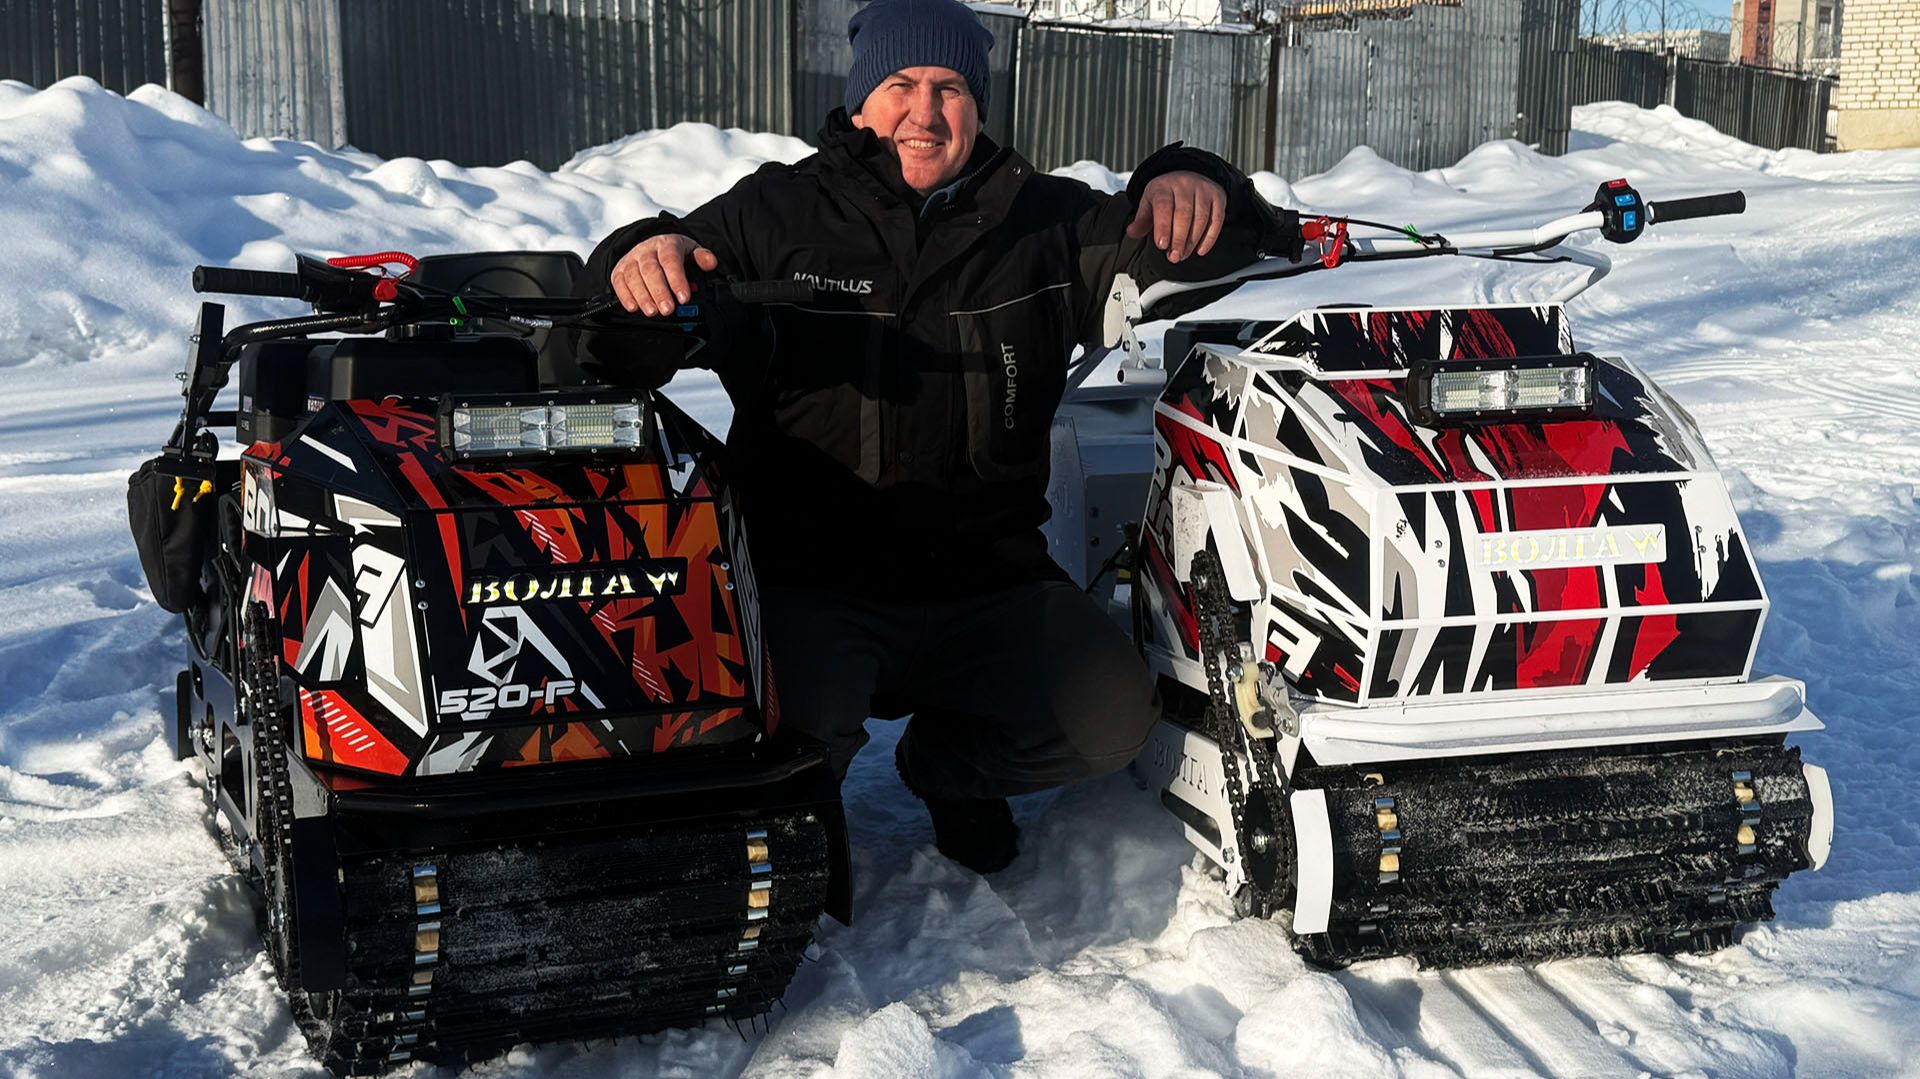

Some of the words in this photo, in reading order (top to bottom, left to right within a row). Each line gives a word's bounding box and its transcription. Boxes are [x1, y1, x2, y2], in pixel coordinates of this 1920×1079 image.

[793, 271, 873, 294] NAUTILUS
[1000, 342, 1018, 430] COMFORT
[1480, 530, 1624, 566] ВОЛГА
[467, 568, 636, 603] ВОЛГА
